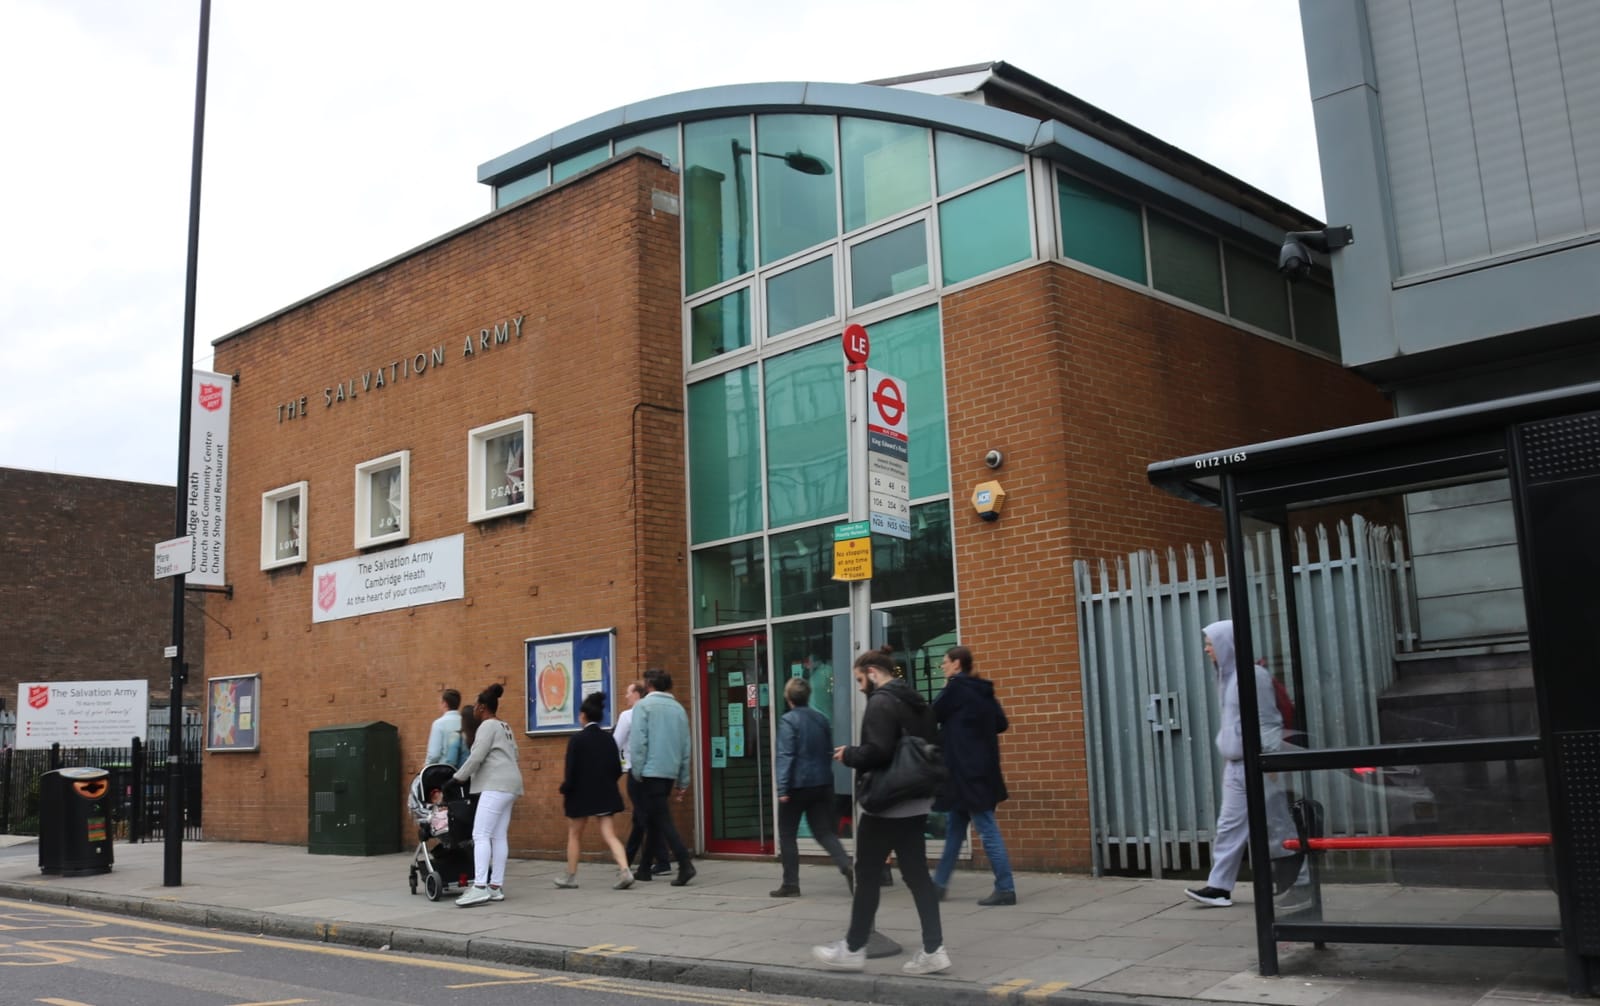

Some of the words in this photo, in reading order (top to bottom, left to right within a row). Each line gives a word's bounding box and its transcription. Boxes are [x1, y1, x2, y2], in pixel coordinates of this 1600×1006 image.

[851, 335, 867, 355] LE
[277, 394, 307, 423] THE
[324, 345, 445, 407] SALVATION
[463, 315, 526, 357] ARMY
[203, 431, 213, 463] Centre
[1223, 451, 1247, 465] 1163
[214, 444, 223, 494] Restaurant
[189, 472, 199, 506] Heath
[201, 465, 212, 518] Community
[491, 481, 526, 500] PEACE
[213, 495, 221, 513] and
[201, 520, 209, 537] and
[212, 515, 222, 538] Shop
[199, 540, 209, 573] Church
[211, 541, 221, 574] Charity
[358, 562, 373, 576] The
[374, 554, 410, 572] Salvation
[411, 549, 434, 567] Army
[347, 597, 355, 606] At
[355, 594, 366, 605] the
[366, 591, 383, 603] heart
[384, 589, 392, 600] of
[392, 588, 408, 601] your
[409, 579, 446, 595] community
[364, 573, 402, 590] Cambridge
[403, 568, 426, 583] Heath
[51, 689, 68, 698] The
[70, 687, 111, 697] Salvation
[114, 687, 138, 699] Army
